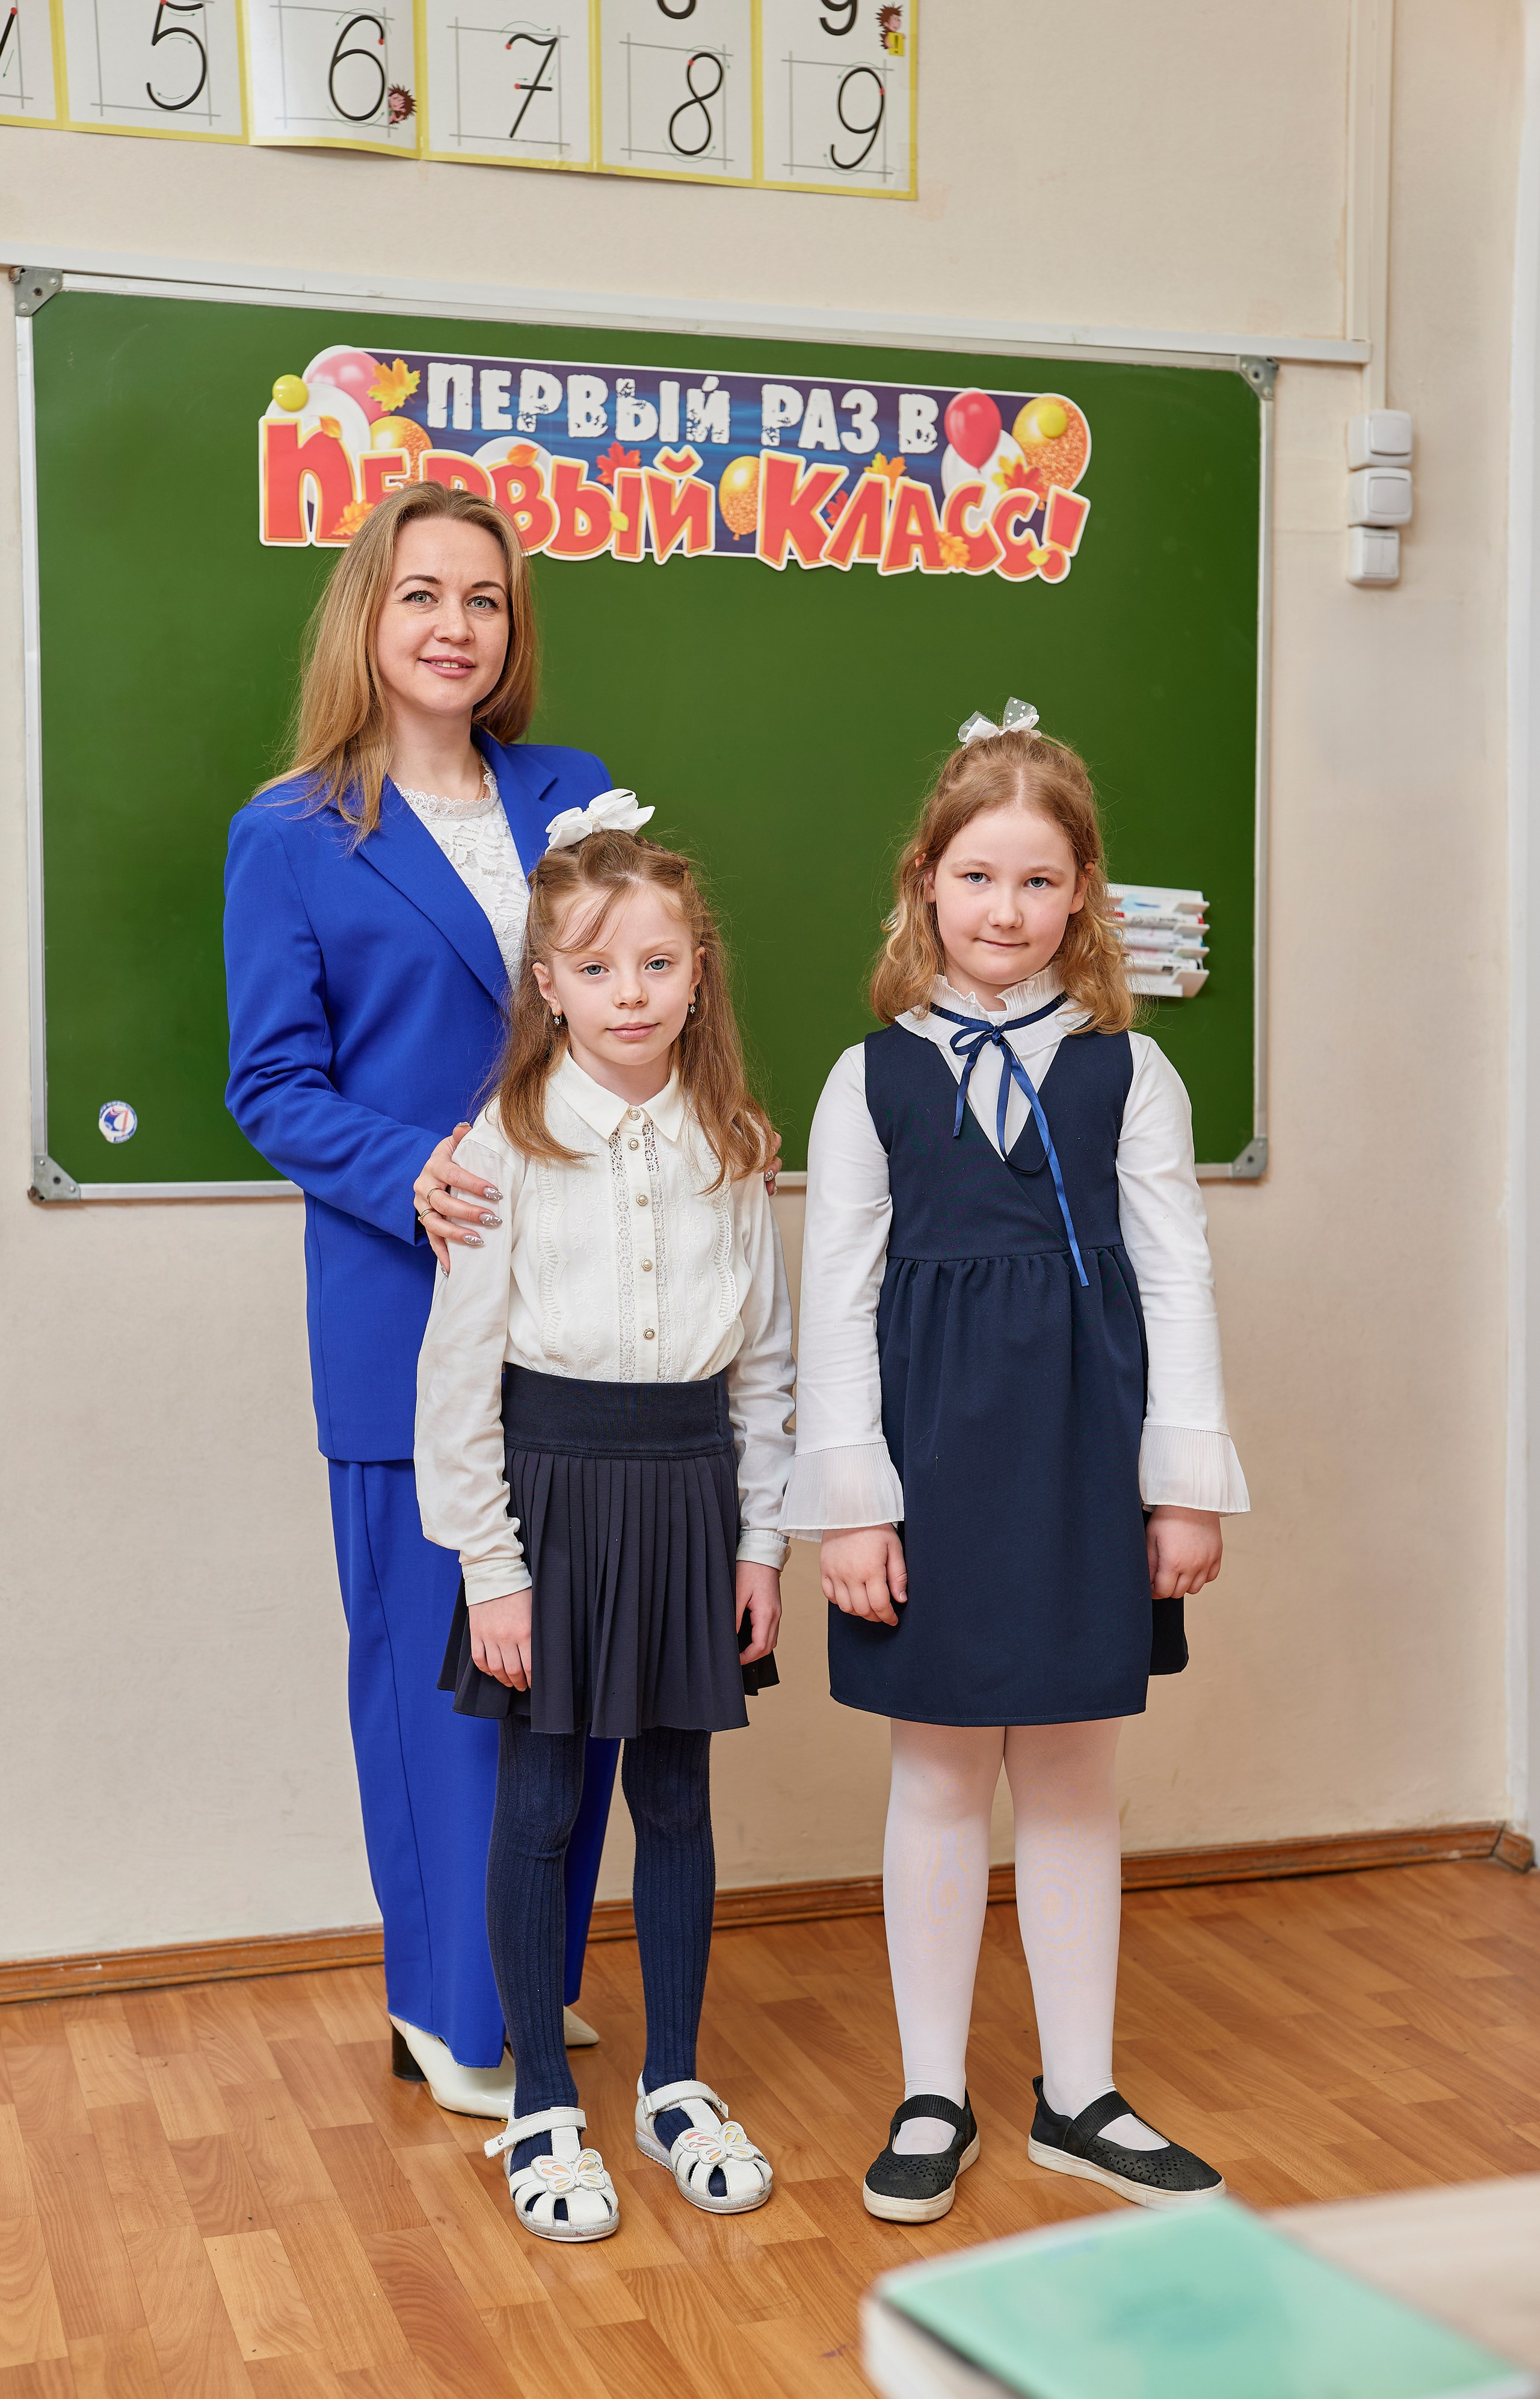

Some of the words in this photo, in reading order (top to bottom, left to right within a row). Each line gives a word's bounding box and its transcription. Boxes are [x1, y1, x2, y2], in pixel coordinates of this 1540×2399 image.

[146, 0, 207, 111] 5
[328, 15, 385, 121] 6
[506, 33, 558, 138] 7
[669, 52, 723, 155] 8
[830, 67, 886, 170] 9
[427, 362, 731, 444] ПЕРВЫЙ
[761, 383, 880, 454] РАЗ
[898, 393, 940, 454] В
[757, 449, 1091, 582] КЛАСС!
